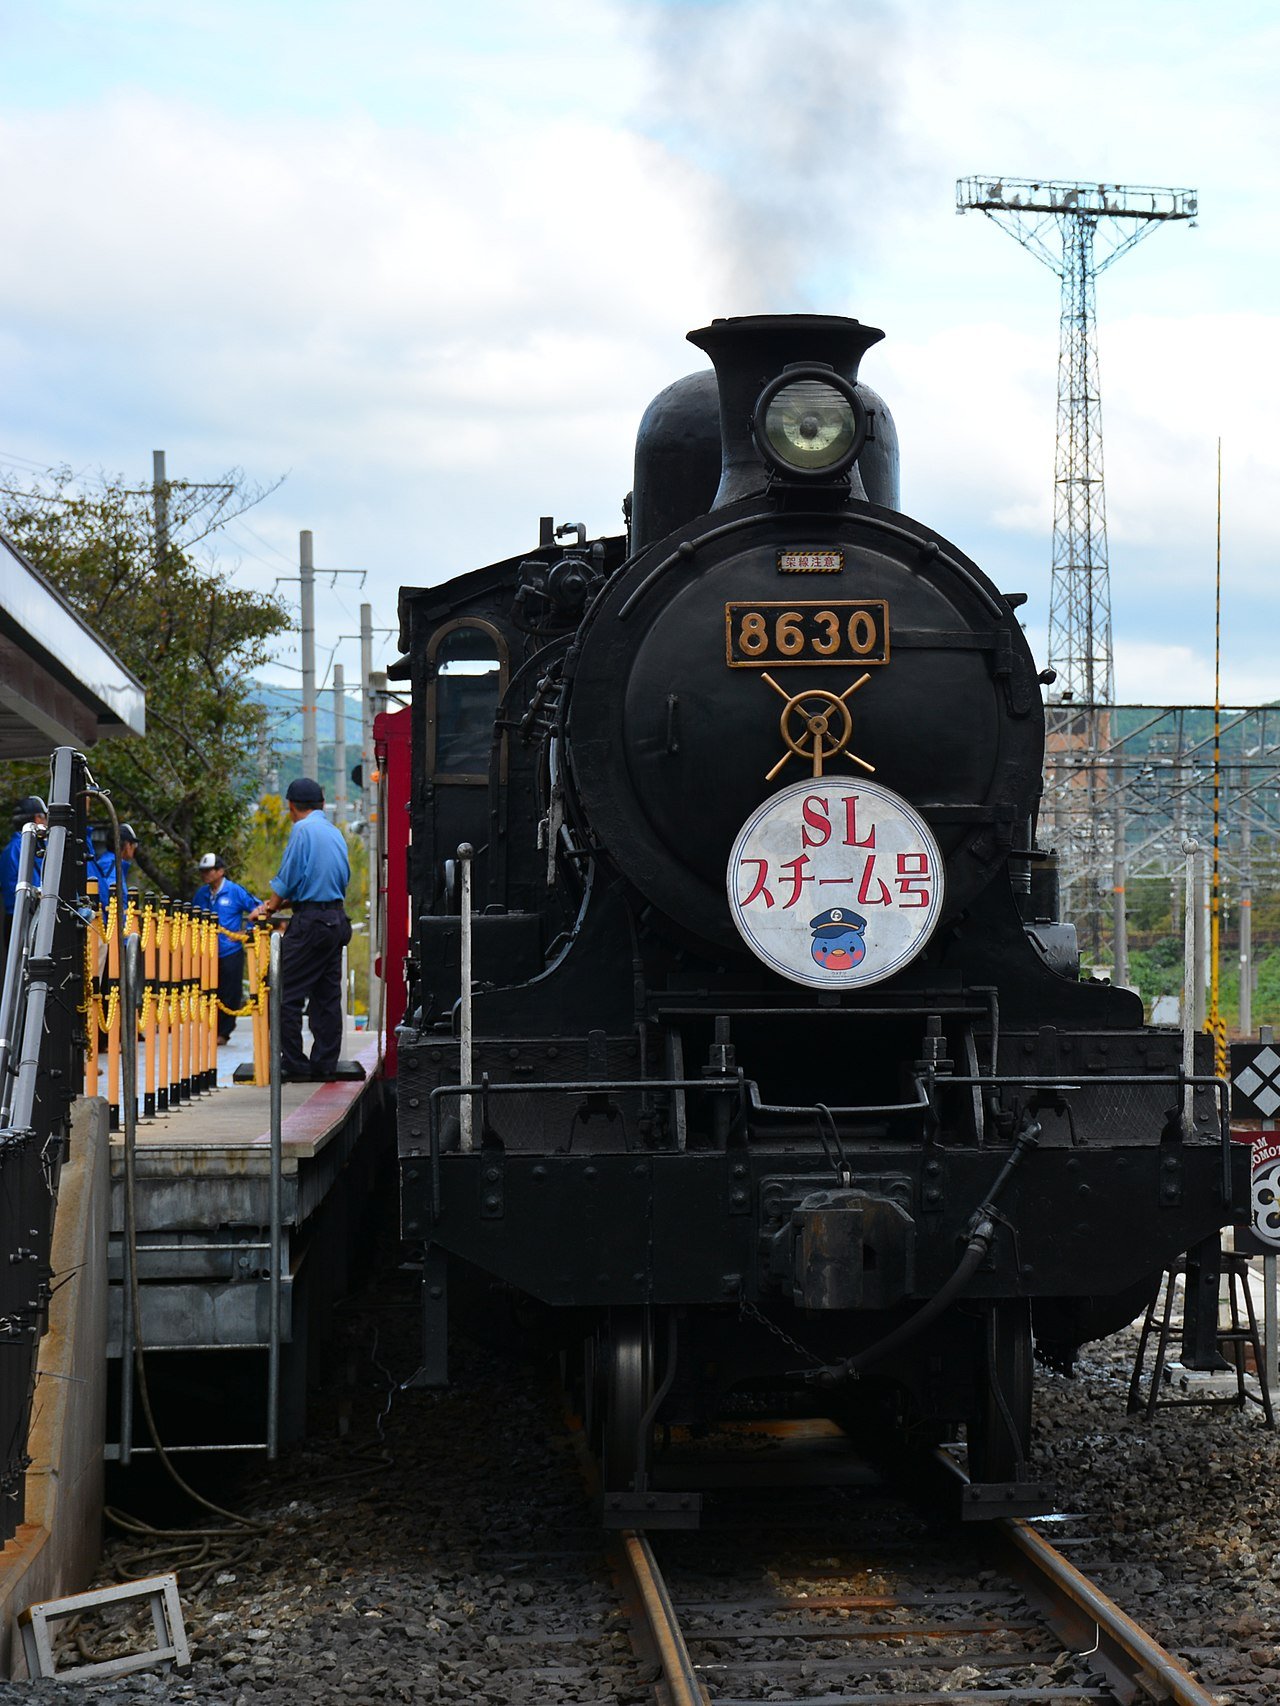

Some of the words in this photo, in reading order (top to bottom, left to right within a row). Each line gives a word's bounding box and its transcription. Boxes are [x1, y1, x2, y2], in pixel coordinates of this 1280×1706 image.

[738, 611, 877, 656] 8630
[801, 795, 876, 850] SL
[739, 852, 932, 910] スチーム号
